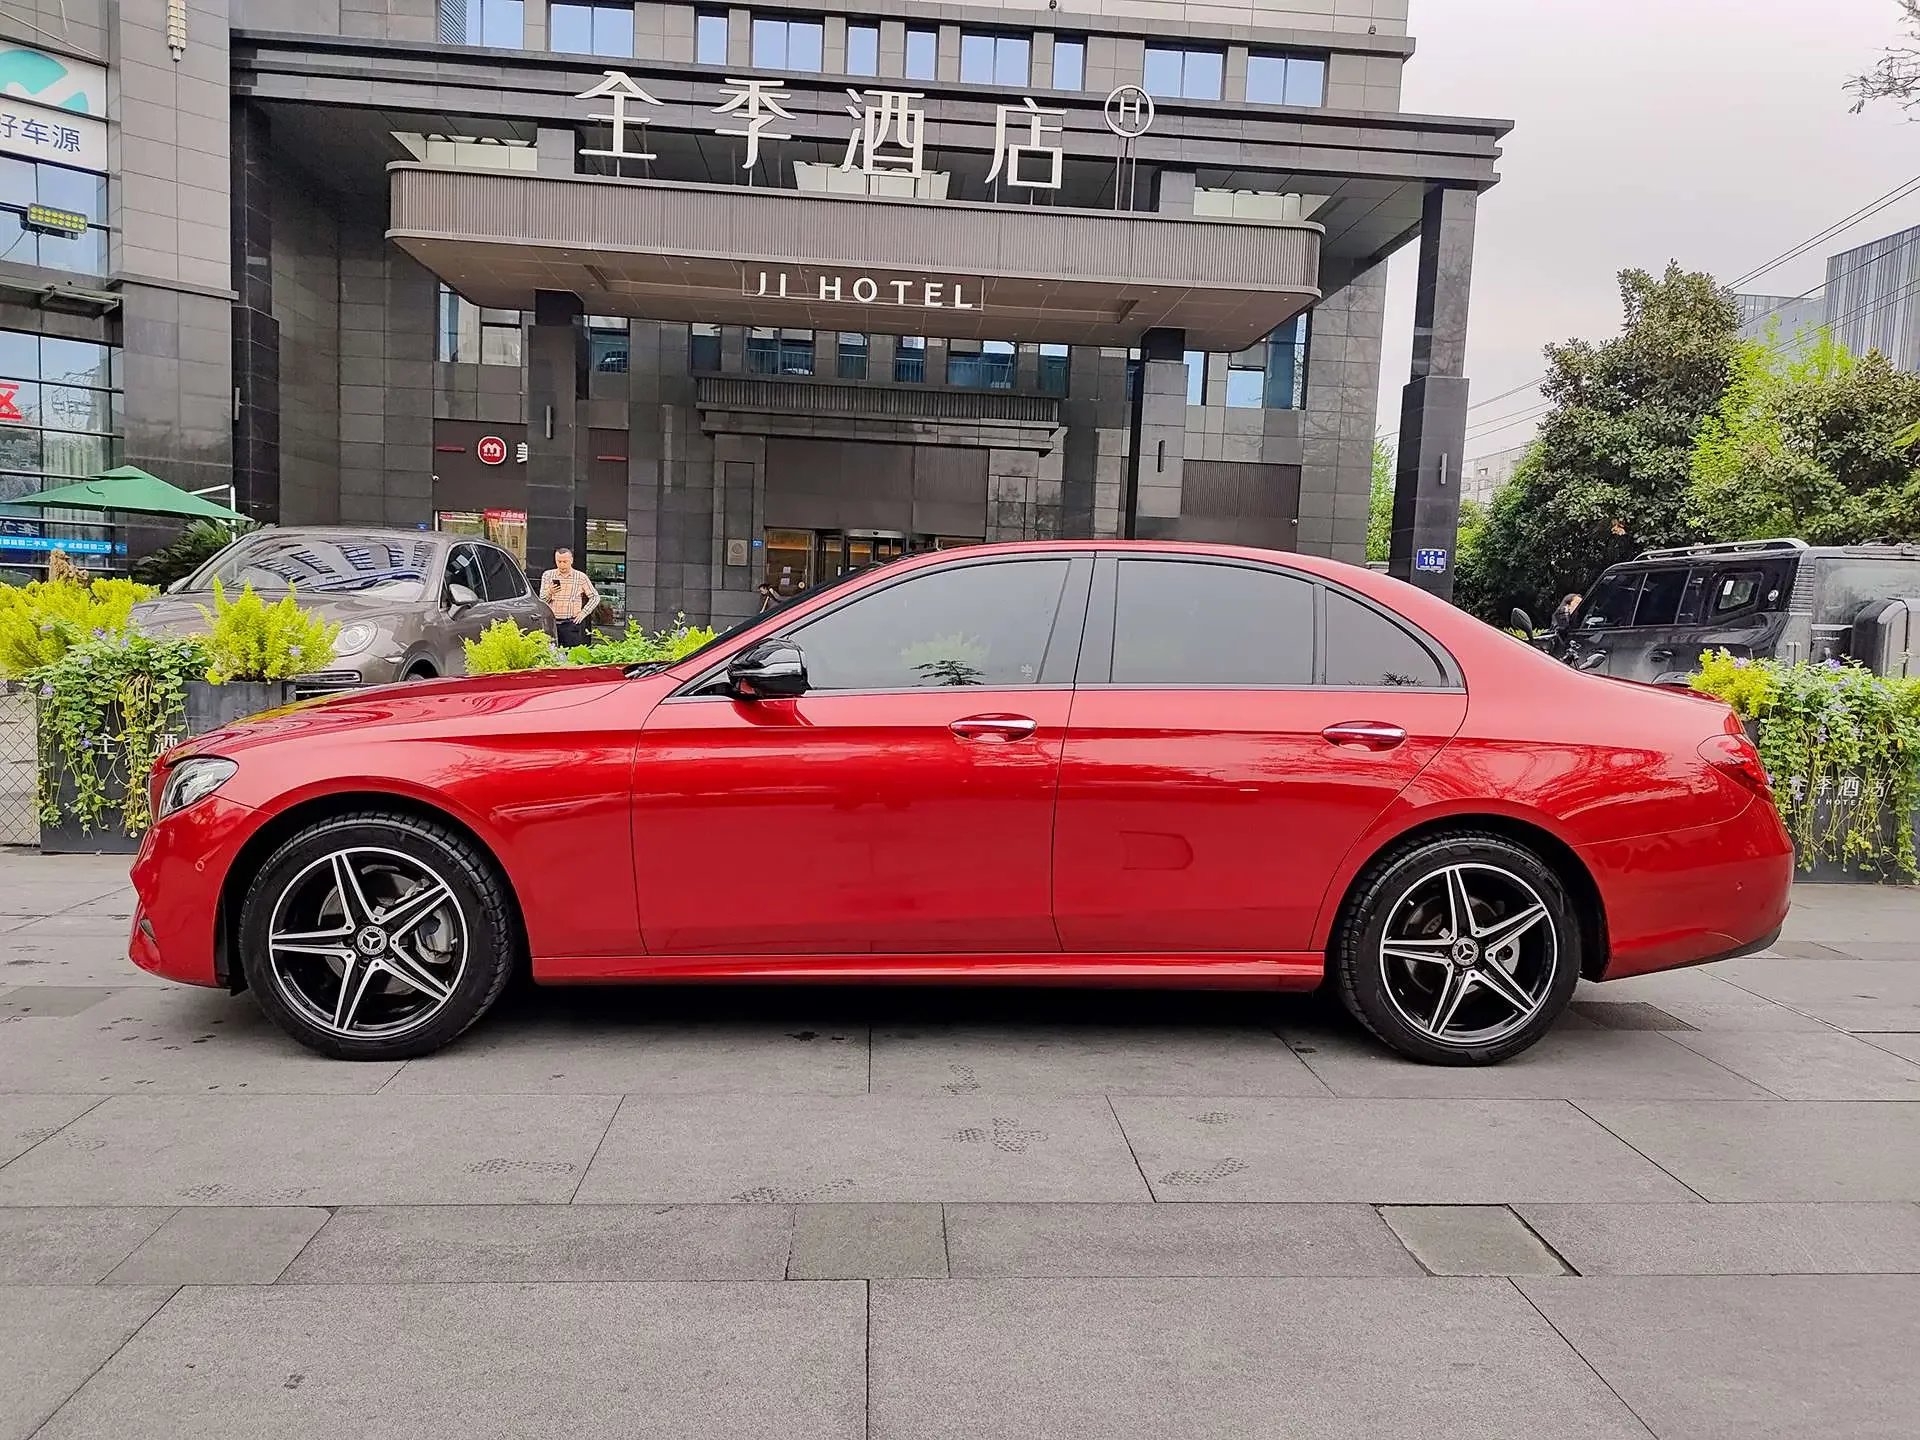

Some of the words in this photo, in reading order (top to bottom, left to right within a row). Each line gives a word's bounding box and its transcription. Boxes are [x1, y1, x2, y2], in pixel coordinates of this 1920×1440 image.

[574, 70, 1068, 189] 全季酒店
[755, 271, 787, 297] JI
[819, 275, 973, 309] HOTEL
[1423, 555, 1436, 565] 16
